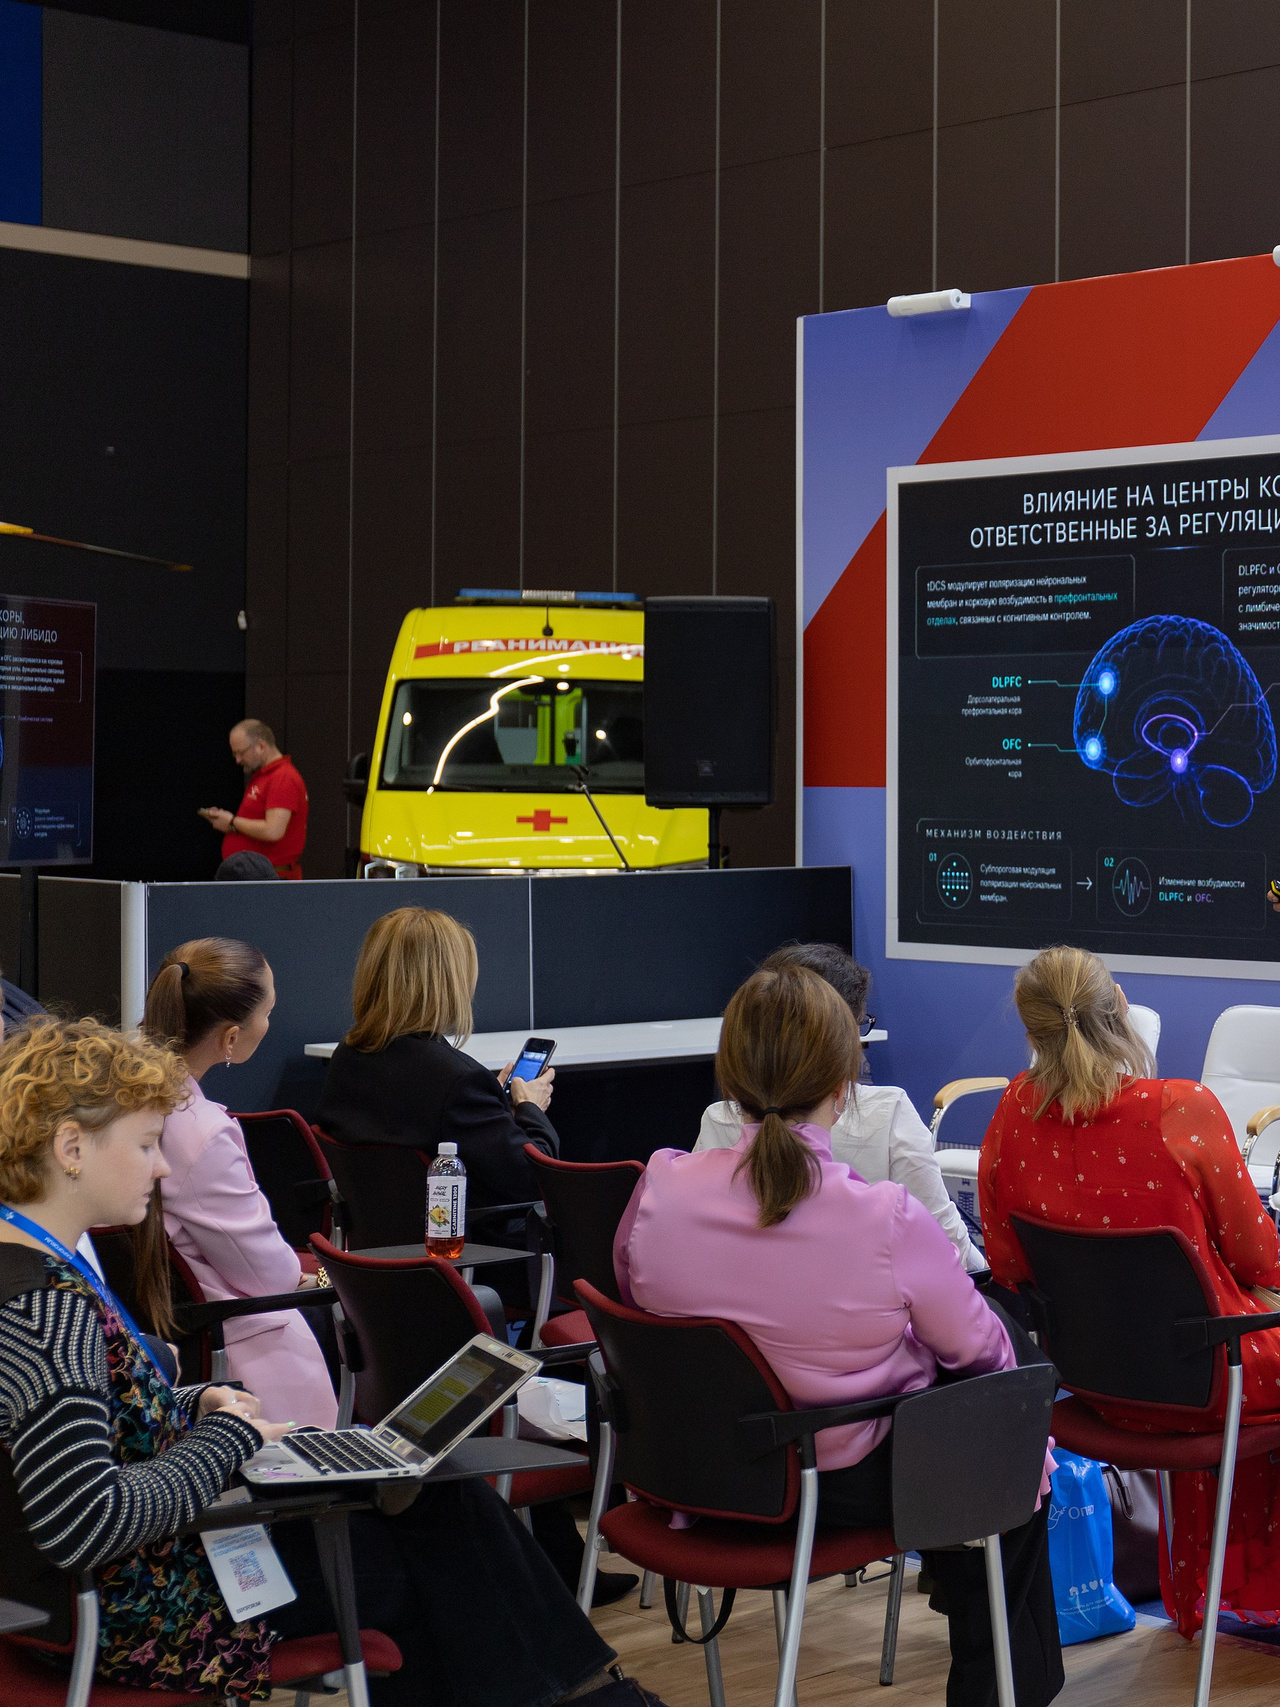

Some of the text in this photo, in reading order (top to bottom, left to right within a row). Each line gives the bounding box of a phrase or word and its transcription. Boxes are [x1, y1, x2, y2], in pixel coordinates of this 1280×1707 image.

[1023, 487, 1118, 515] ВЛИЯНИЕ
[1126, 485, 1154, 507] НА
[1164, 477, 1249, 507] ЦЕНТРЫ
[970, 517, 1138, 548] ОТВЕТСТВЕННЫЕ
[1145, 515, 1171, 538] ЗА
[1238, 563, 1267, 576] DLPFC
[1269, 566, 1275, 574] и
[947, 581, 988, 591] модулирует
[989, 578, 1035, 589] поляризацию
[1036, 575, 1087, 587] нейрональных
[927, 597, 957, 610] мембран
[958, 600, 964, 608] и
[998, 593, 1047, 606] возбудимость
[1054, 592, 1118, 605] префронтальных
[1238, 605, 1243, 613] с
[20, 628, 58, 643] ЛИБИДО
[992, 676, 1022, 688] DLPFC
[1002, 738, 1022, 750] OFC
[1008, 770, 1022, 779] кора
[926, 828, 1062, 840] МЕХАНИЗМ ВОЗДЕЙСТВИЯ
[929, 852, 937, 862] 01
[1104, 857, 1114, 867] 02
[1159, 876, 1246, 889] Изменение возбудимости
[1159, 892, 1184, 902] DLPFC
[1187, 894, 1192, 902] и
